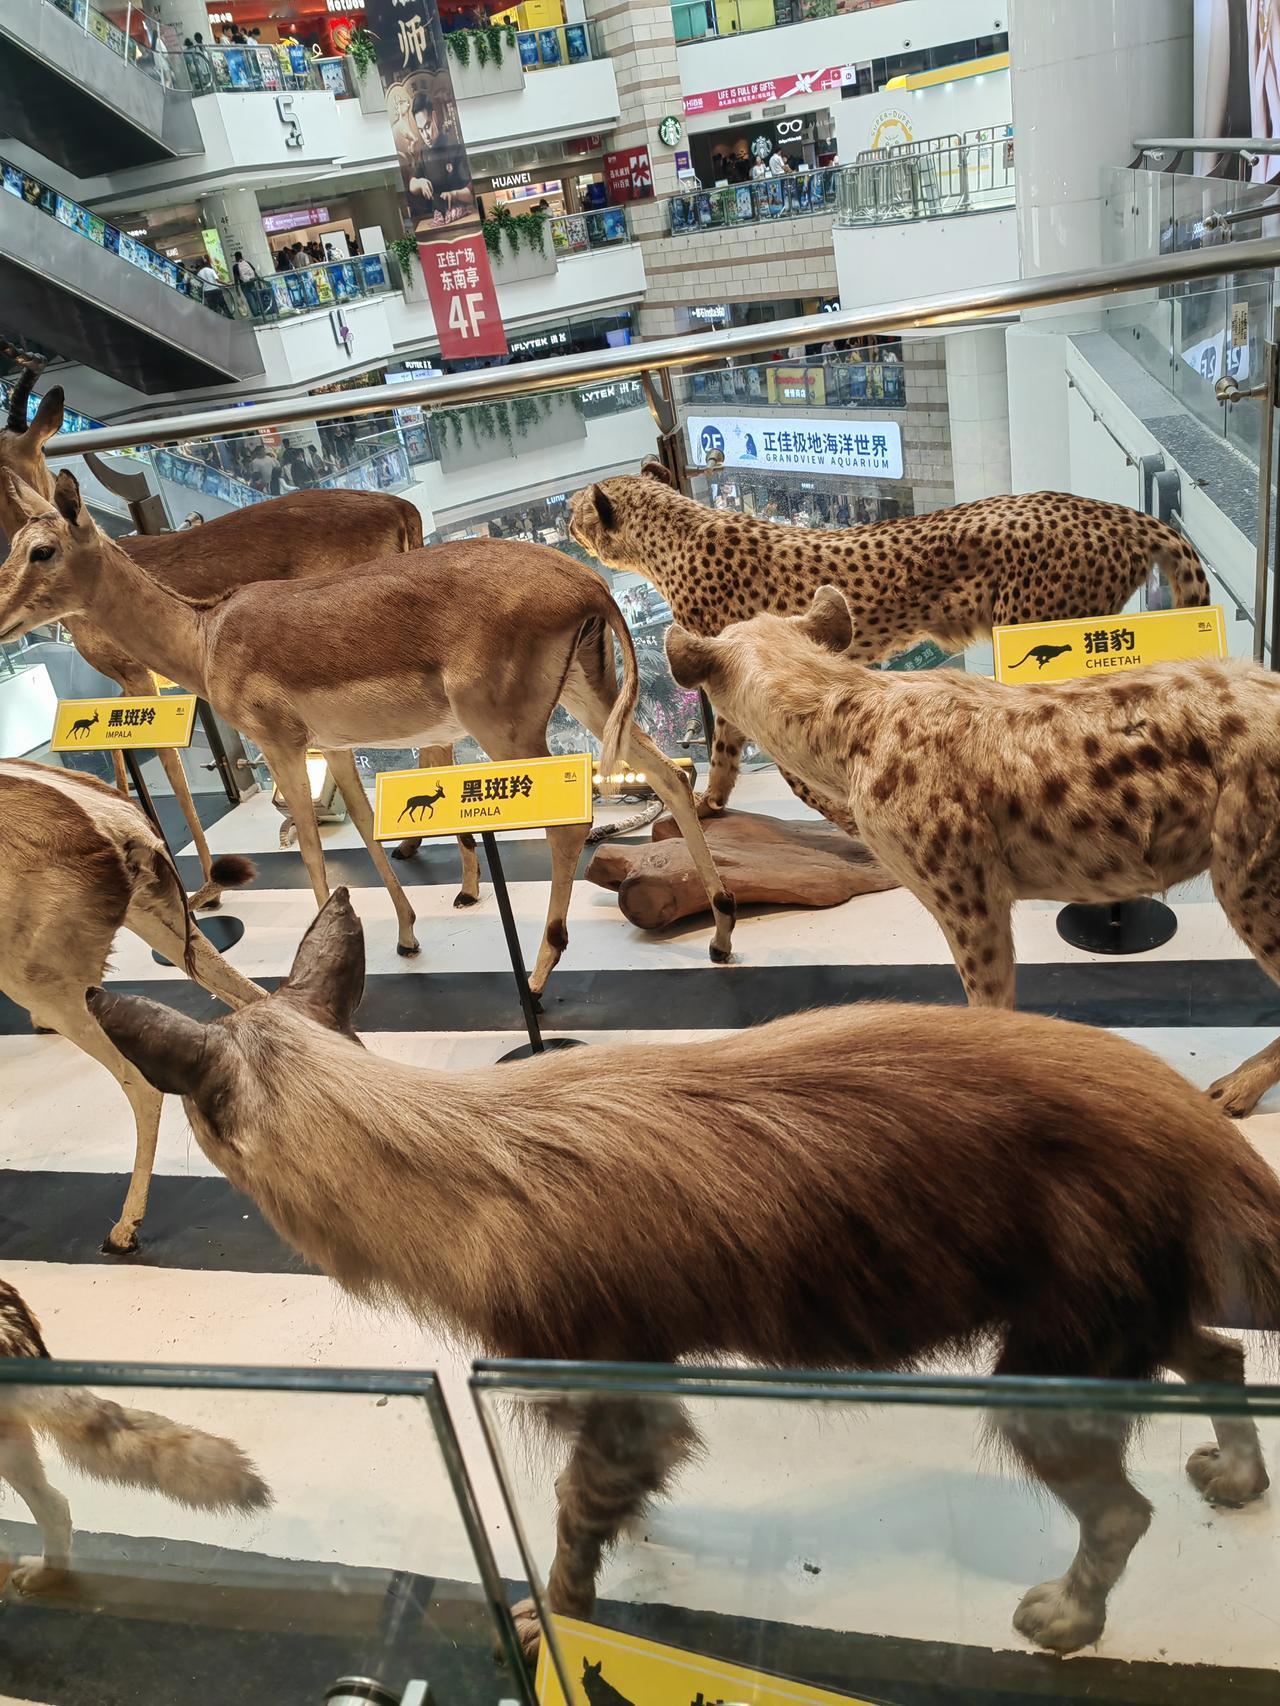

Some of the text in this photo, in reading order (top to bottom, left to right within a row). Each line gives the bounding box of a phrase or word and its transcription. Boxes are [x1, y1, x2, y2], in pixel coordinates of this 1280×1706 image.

[717, 89, 729, 100] LIFE
[730, 87, 737, 98] IS
[737, 85, 751, 96] FULL
[752, 83, 759, 94] OF
[491, 172, 532, 189] HUAWEI
[436, 247, 475, 268] 正佳广场
[440, 267, 480, 291] 东南亭
[449, 292, 486, 339] 4F
[762, 431, 889, 457] 正佳极地海洋世界
[765, 453, 890, 469] GRANDVIEW AQUARIUM
[1083, 628, 1135, 654] 猎豹
[1086, 655, 1141, 669] CHEETAH
[108, 707, 157, 727] 黑斑羚
[105, 731, 132, 739] IMPALA
[460, 774, 534, 804] 黑斑羚
[460, 806, 501, 818] IMPALA
